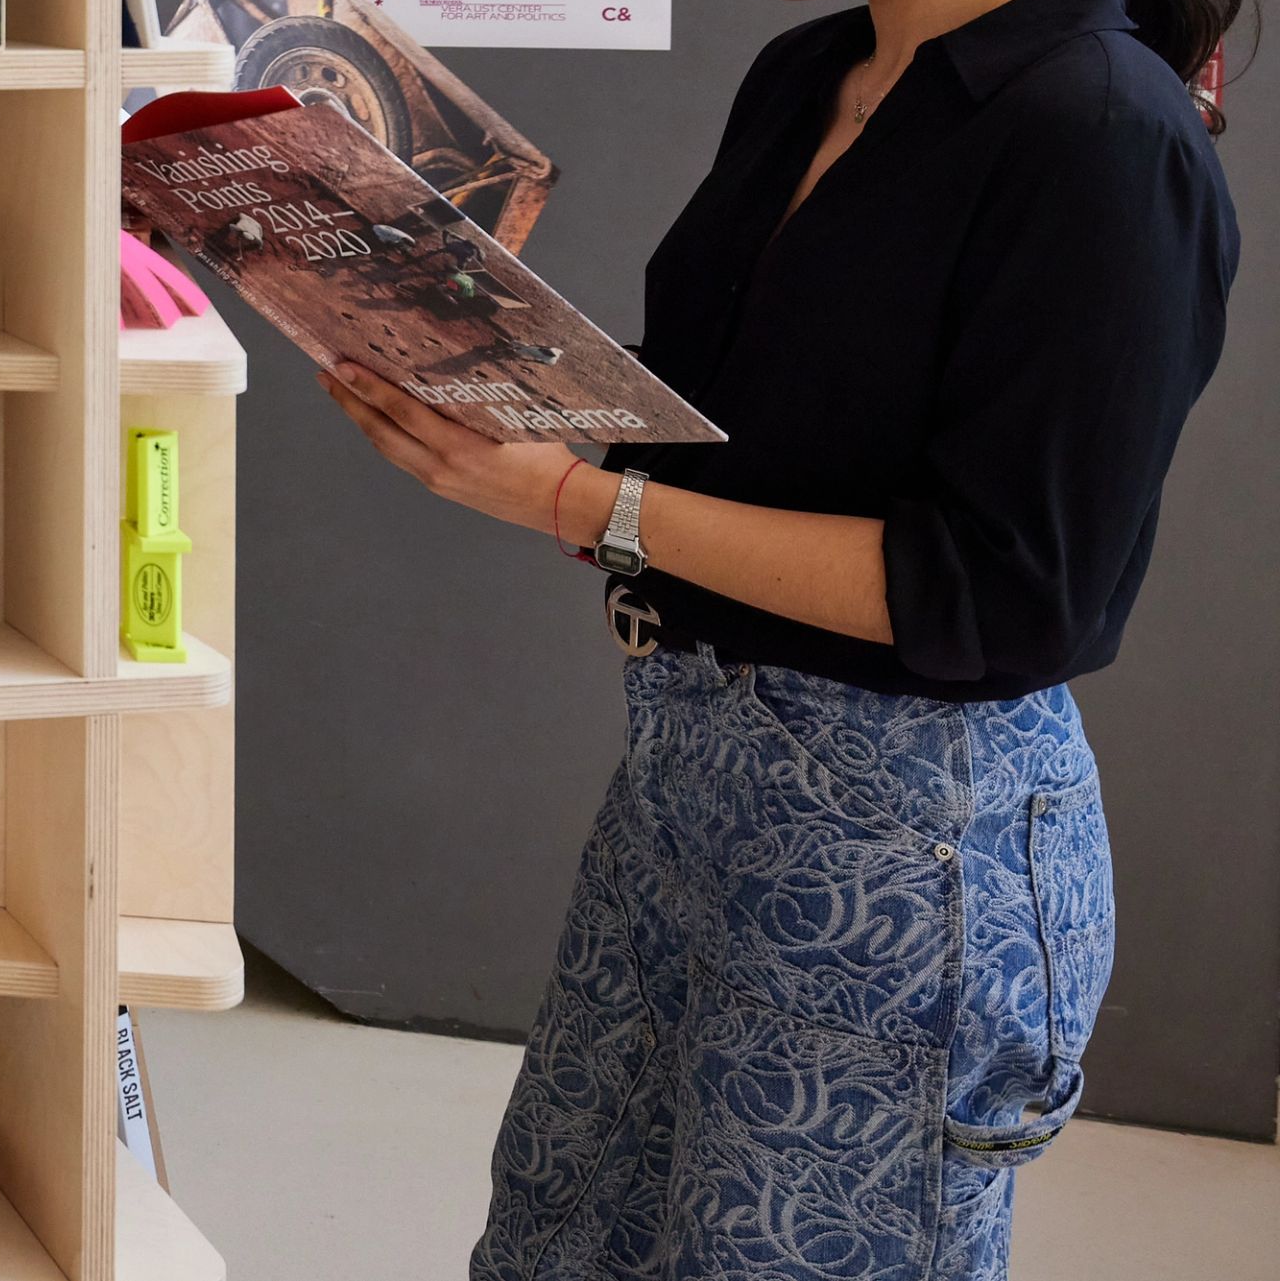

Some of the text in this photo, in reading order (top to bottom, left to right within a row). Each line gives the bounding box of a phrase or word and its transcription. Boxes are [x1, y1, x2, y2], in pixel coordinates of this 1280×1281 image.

[441, 4, 542, 13] VERA LIST CENTER
[441, 12, 567, 21] FOR ART AND POLITICS
[601, 6, 632, 22] C&
[136, 142, 290, 192] Vanishing
[175, 179, 271, 215] Points
[284, 228, 373, 263] 2020
[400, 378, 532, 405] Ibrahim
[486, 404, 648, 430] Mahama
[159, 447, 169, 527] Correction
[123, 1082, 143, 1120] SALT
